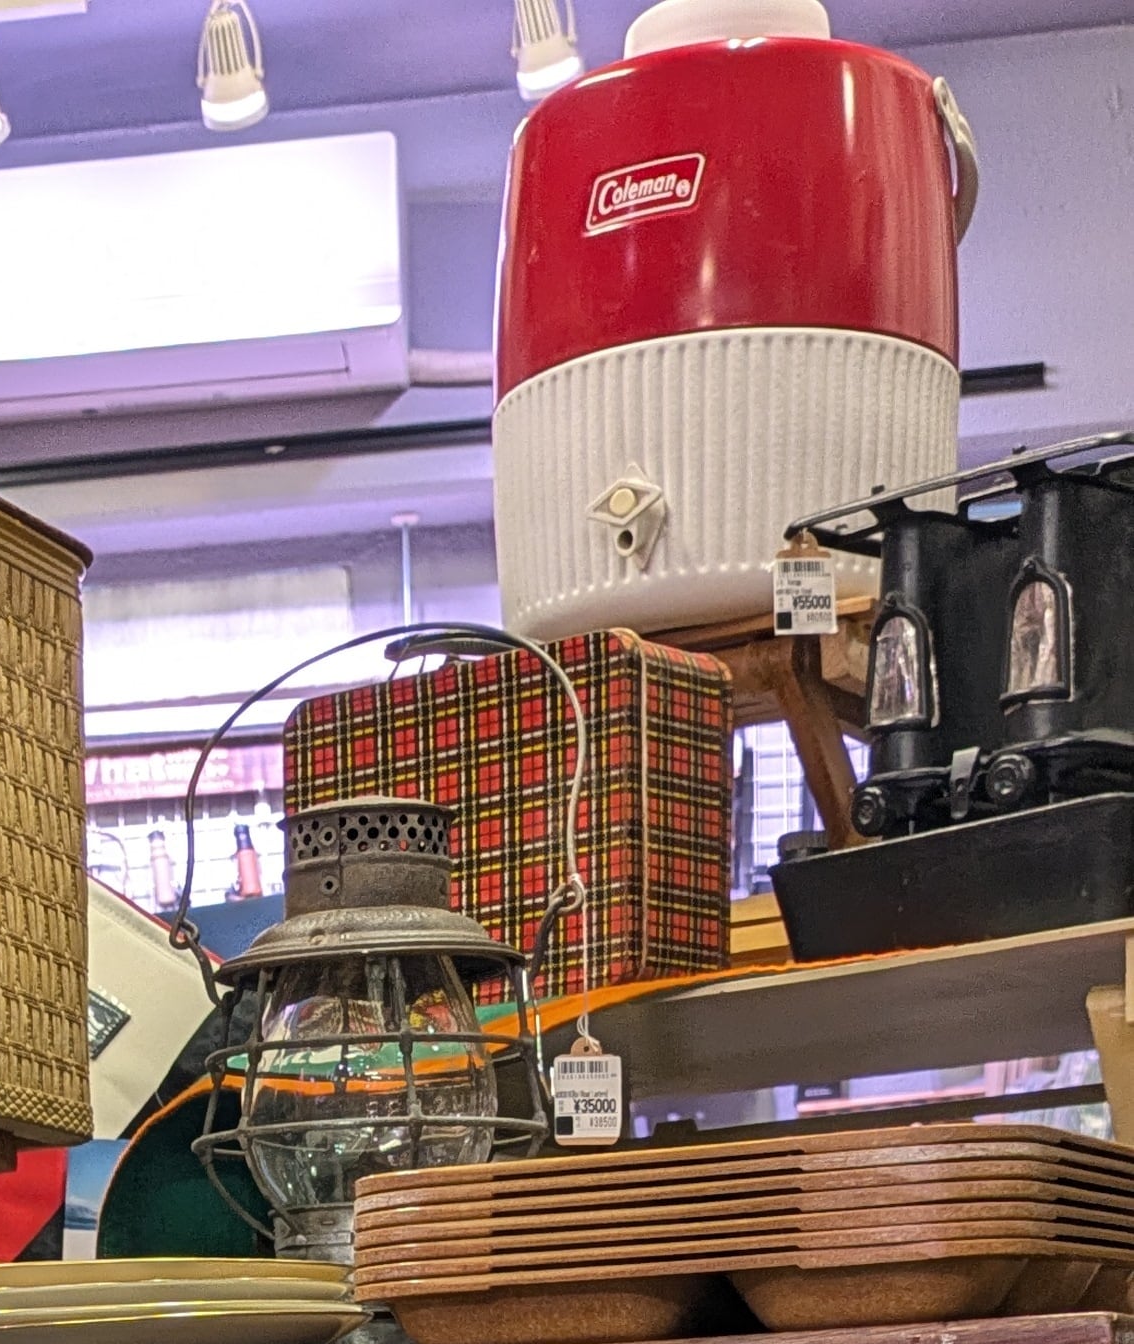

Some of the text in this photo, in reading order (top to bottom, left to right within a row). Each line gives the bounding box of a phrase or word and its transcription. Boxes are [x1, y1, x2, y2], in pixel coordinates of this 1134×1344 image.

[598, 173, 677, 215] Coleman
[792, 595, 832, 610] ¥55000
[573, 1098, 617, 1113] ¥35000
